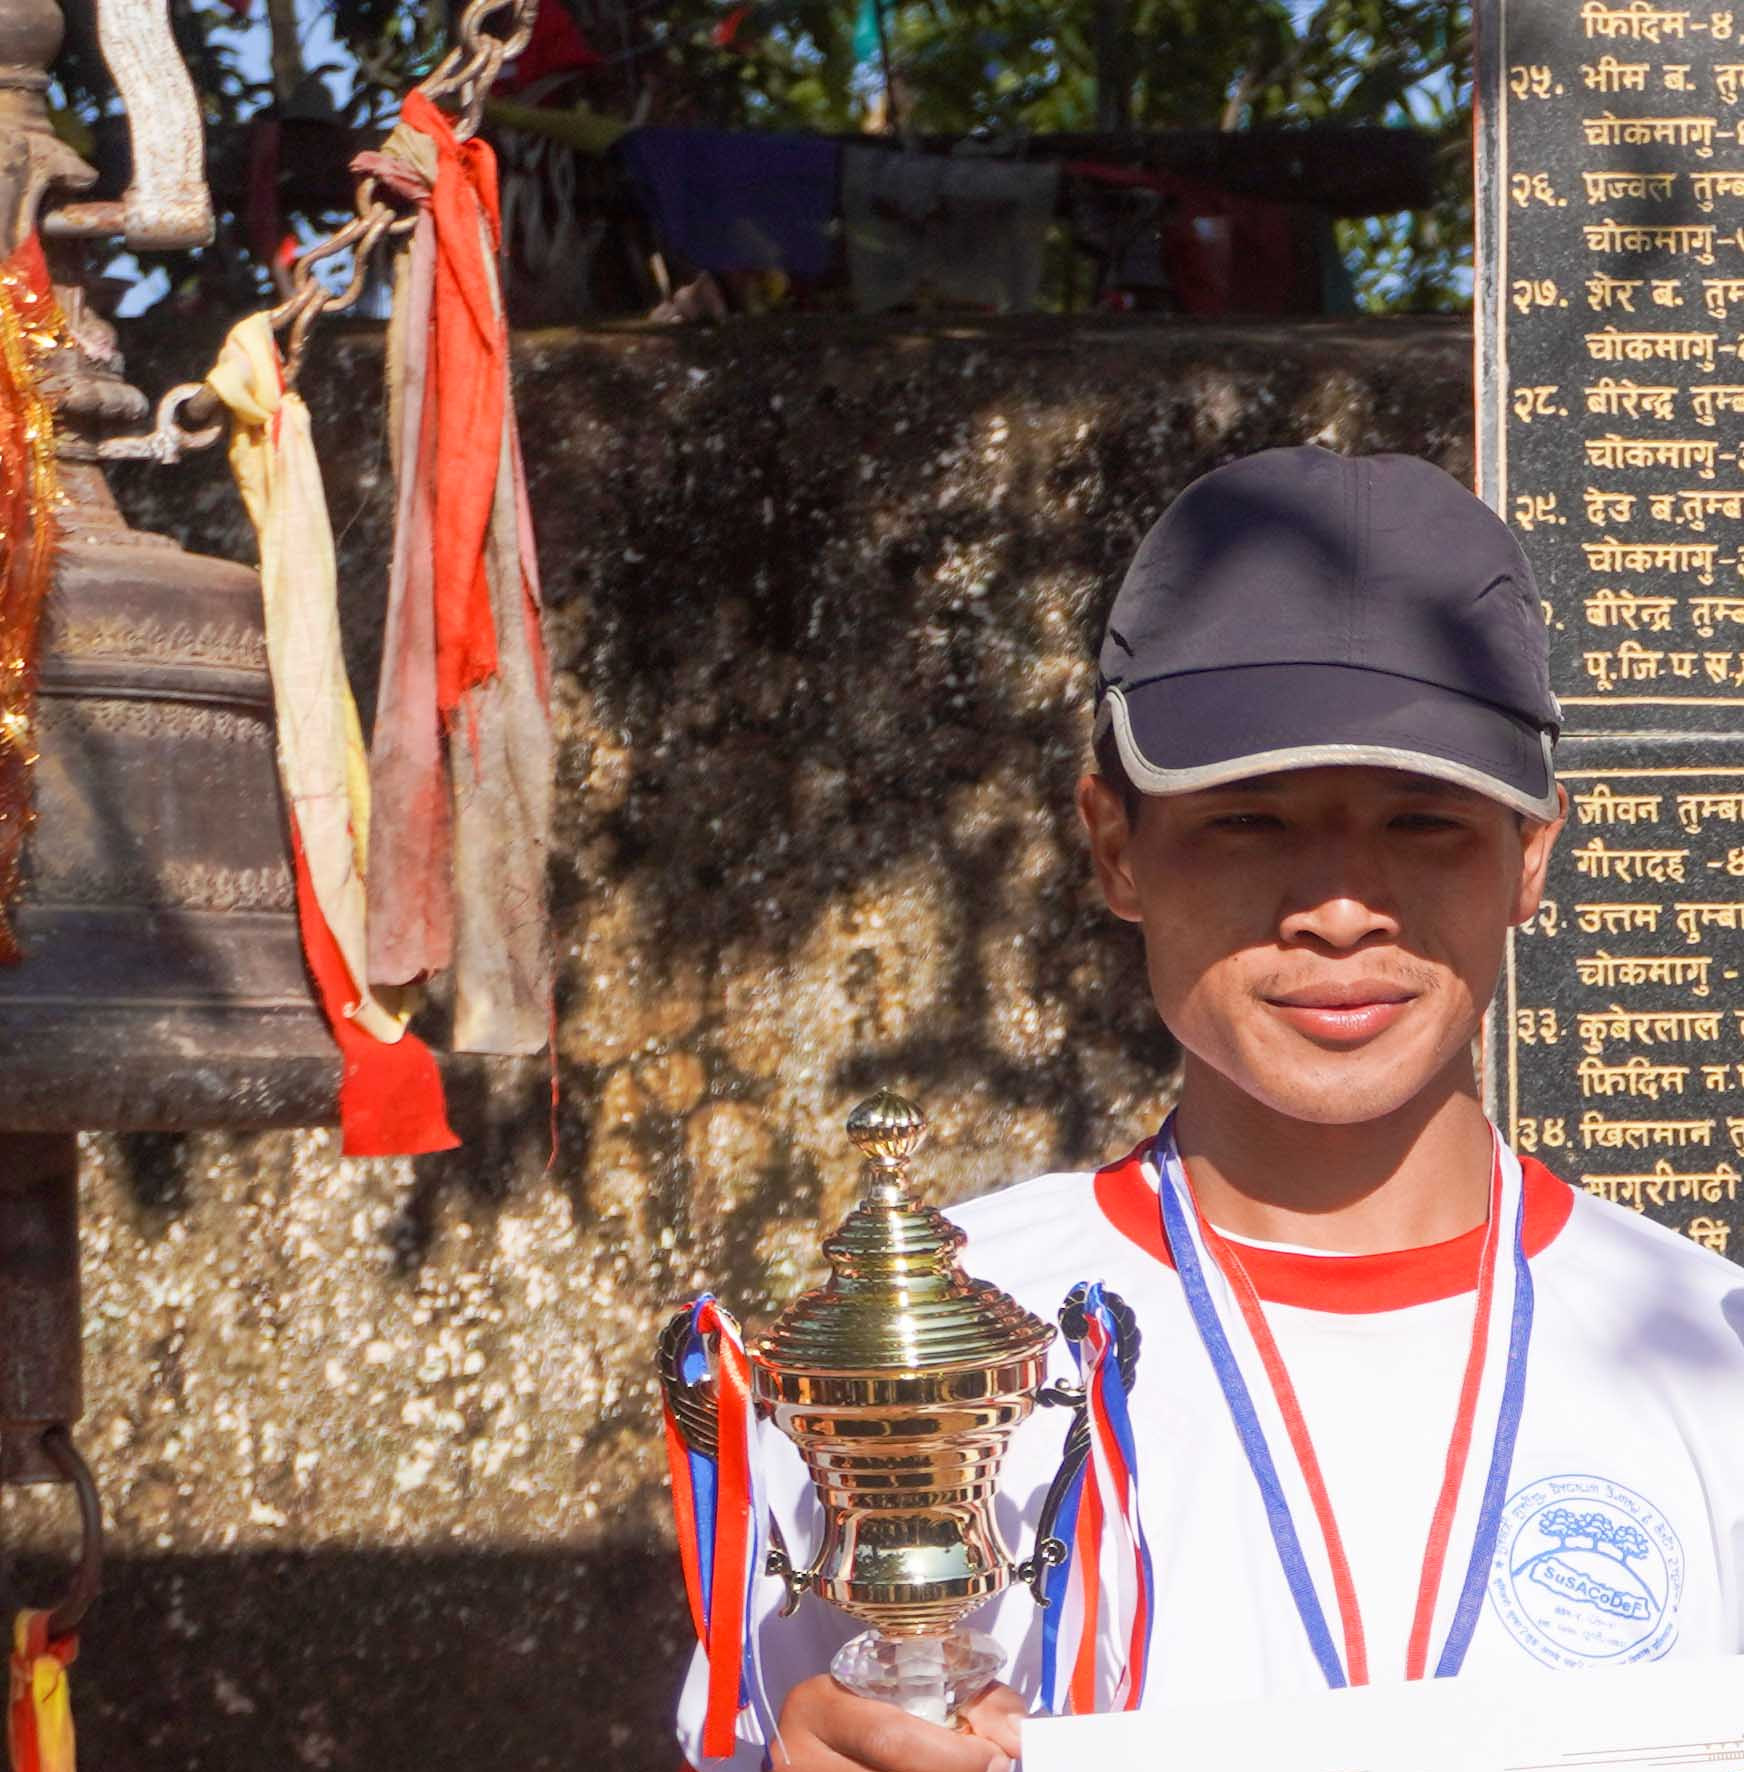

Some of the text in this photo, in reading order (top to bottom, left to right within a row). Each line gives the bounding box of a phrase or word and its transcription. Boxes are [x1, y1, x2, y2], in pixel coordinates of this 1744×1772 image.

[1582, 56, 1649, 92] भीम
[1582, 171, 1677, 205] प्रज्वल
[1585, 271, 1644, 312] शेर
[1583, 487, 1637, 525] देउ
[1574, 783, 1663, 825] जीवन
[1574, 902, 1662, 936] उत्तम
[1576, 950, 1713, 997] चोकमागु
[1577, 1057, 1690, 1099] फिदिम
[1580, 1111, 1716, 1150] खिलमान
